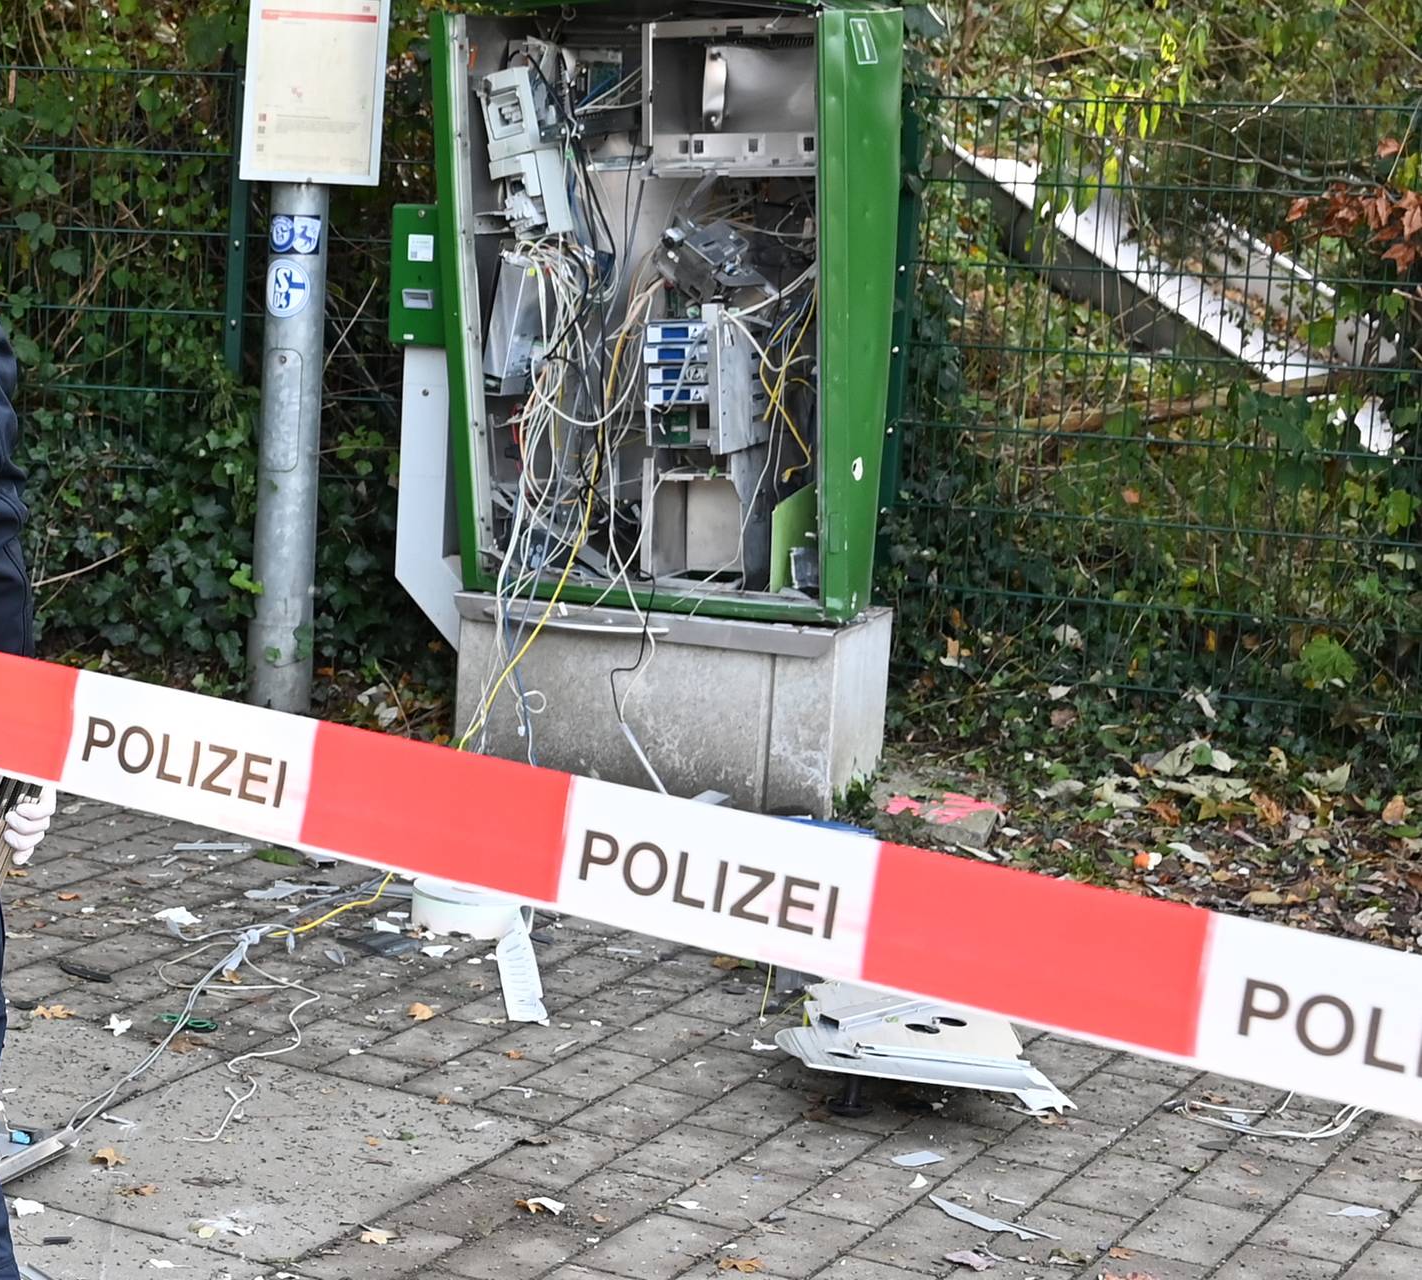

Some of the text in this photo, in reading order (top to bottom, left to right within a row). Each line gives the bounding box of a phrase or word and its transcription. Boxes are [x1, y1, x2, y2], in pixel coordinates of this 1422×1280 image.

[81, 716, 288, 808] POLIZEI
[578, 829, 841, 940] POLIZEI
[1237, 977, 1422, 1079] POL
